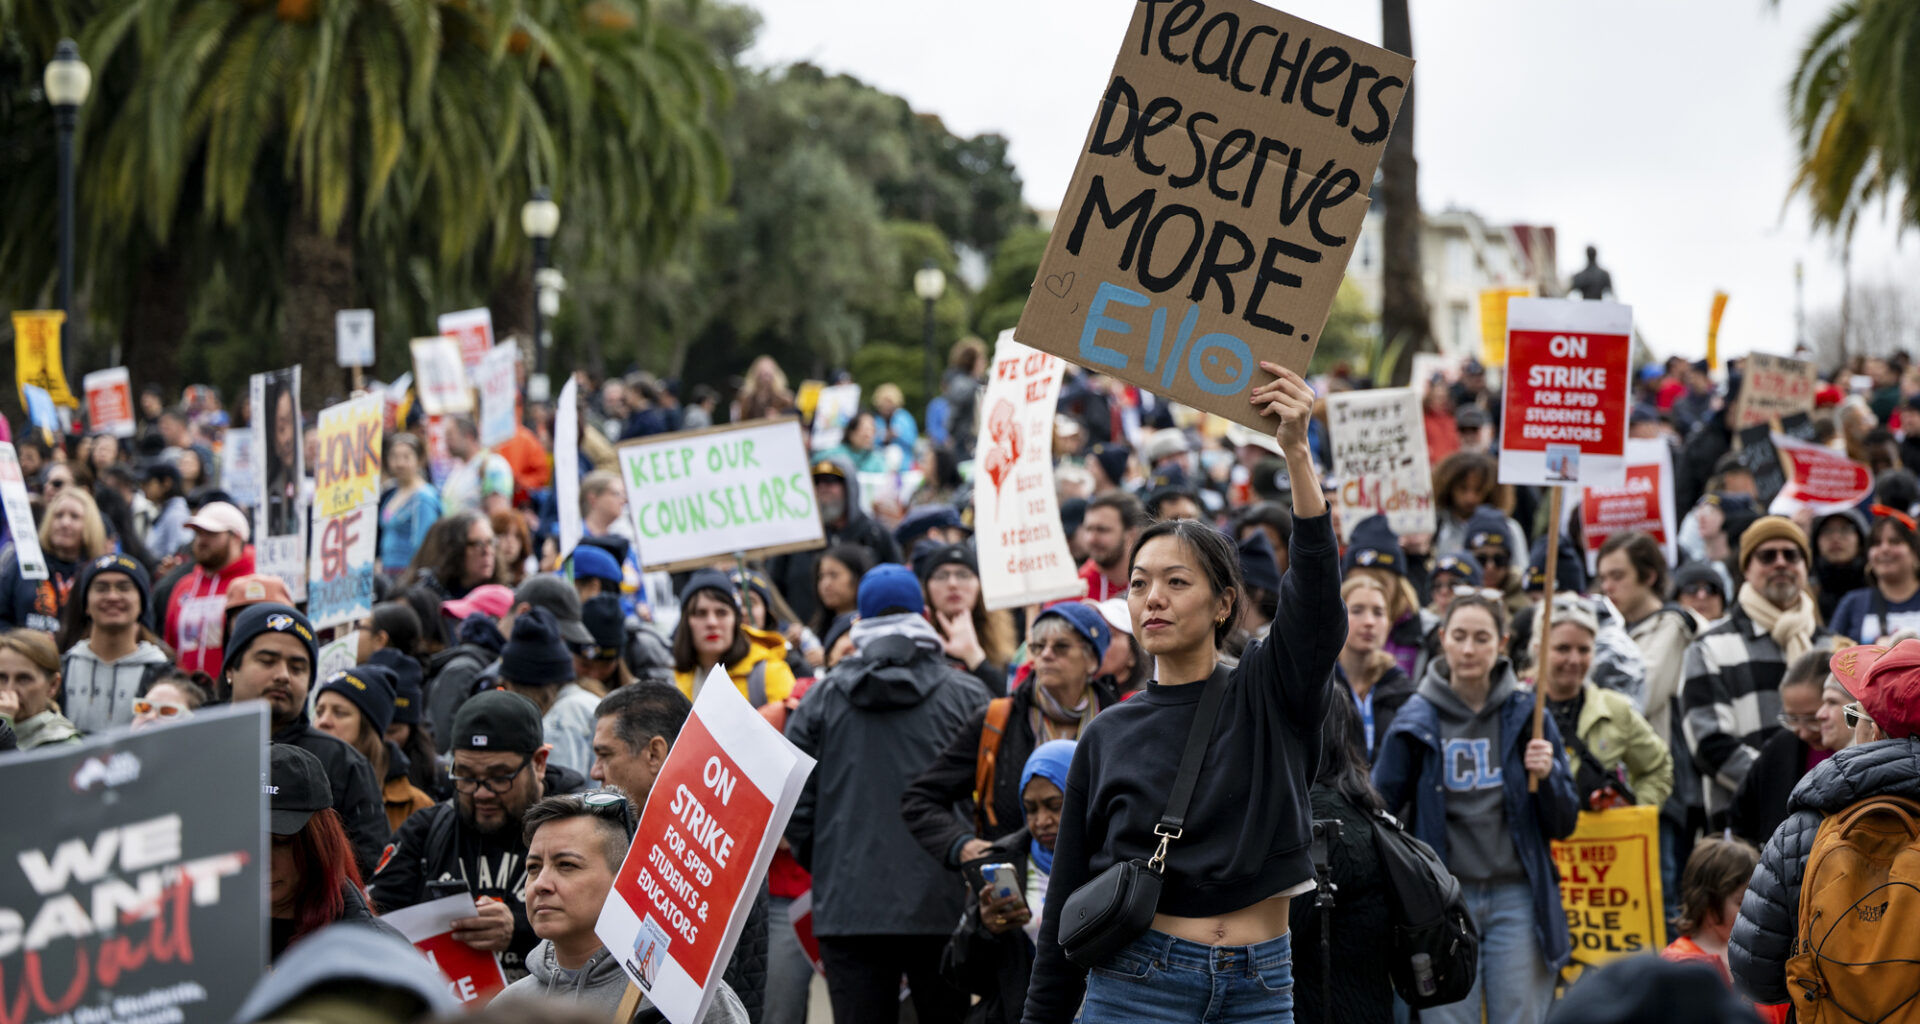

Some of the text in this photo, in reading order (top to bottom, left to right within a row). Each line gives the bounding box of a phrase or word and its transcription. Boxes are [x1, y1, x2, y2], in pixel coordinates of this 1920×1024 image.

[1066, 174, 1323, 342] MORE.
[997, 358, 1019, 381] WE
[1549, 335, 1588, 359] ON
[1527, 364, 1607, 390] STRIKE
[1533, 390, 1599, 407] FOR SPED
[1522, 424, 1603, 442] EDUCATORS
[1525, 407, 1606, 425] STUDENTS &
[315, 420, 380, 490] HONK
[629, 438, 760, 488] KEEP OUR
[639, 473, 812, 538] COUNSELORS
[320, 510, 363, 583] SF
[703, 755, 738, 807] ON
[17, 813, 182, 896] WE
[669, 783, 735, 870] STRIKE
[1580, 844, 1617, 863] NEED
[648, 844, 700, 910] STUDENTS
[697, 901, 709, 923] &
[663, 824, 713, 887] FOR SPED
[636, 866, 699, 945] EDUCATORS
